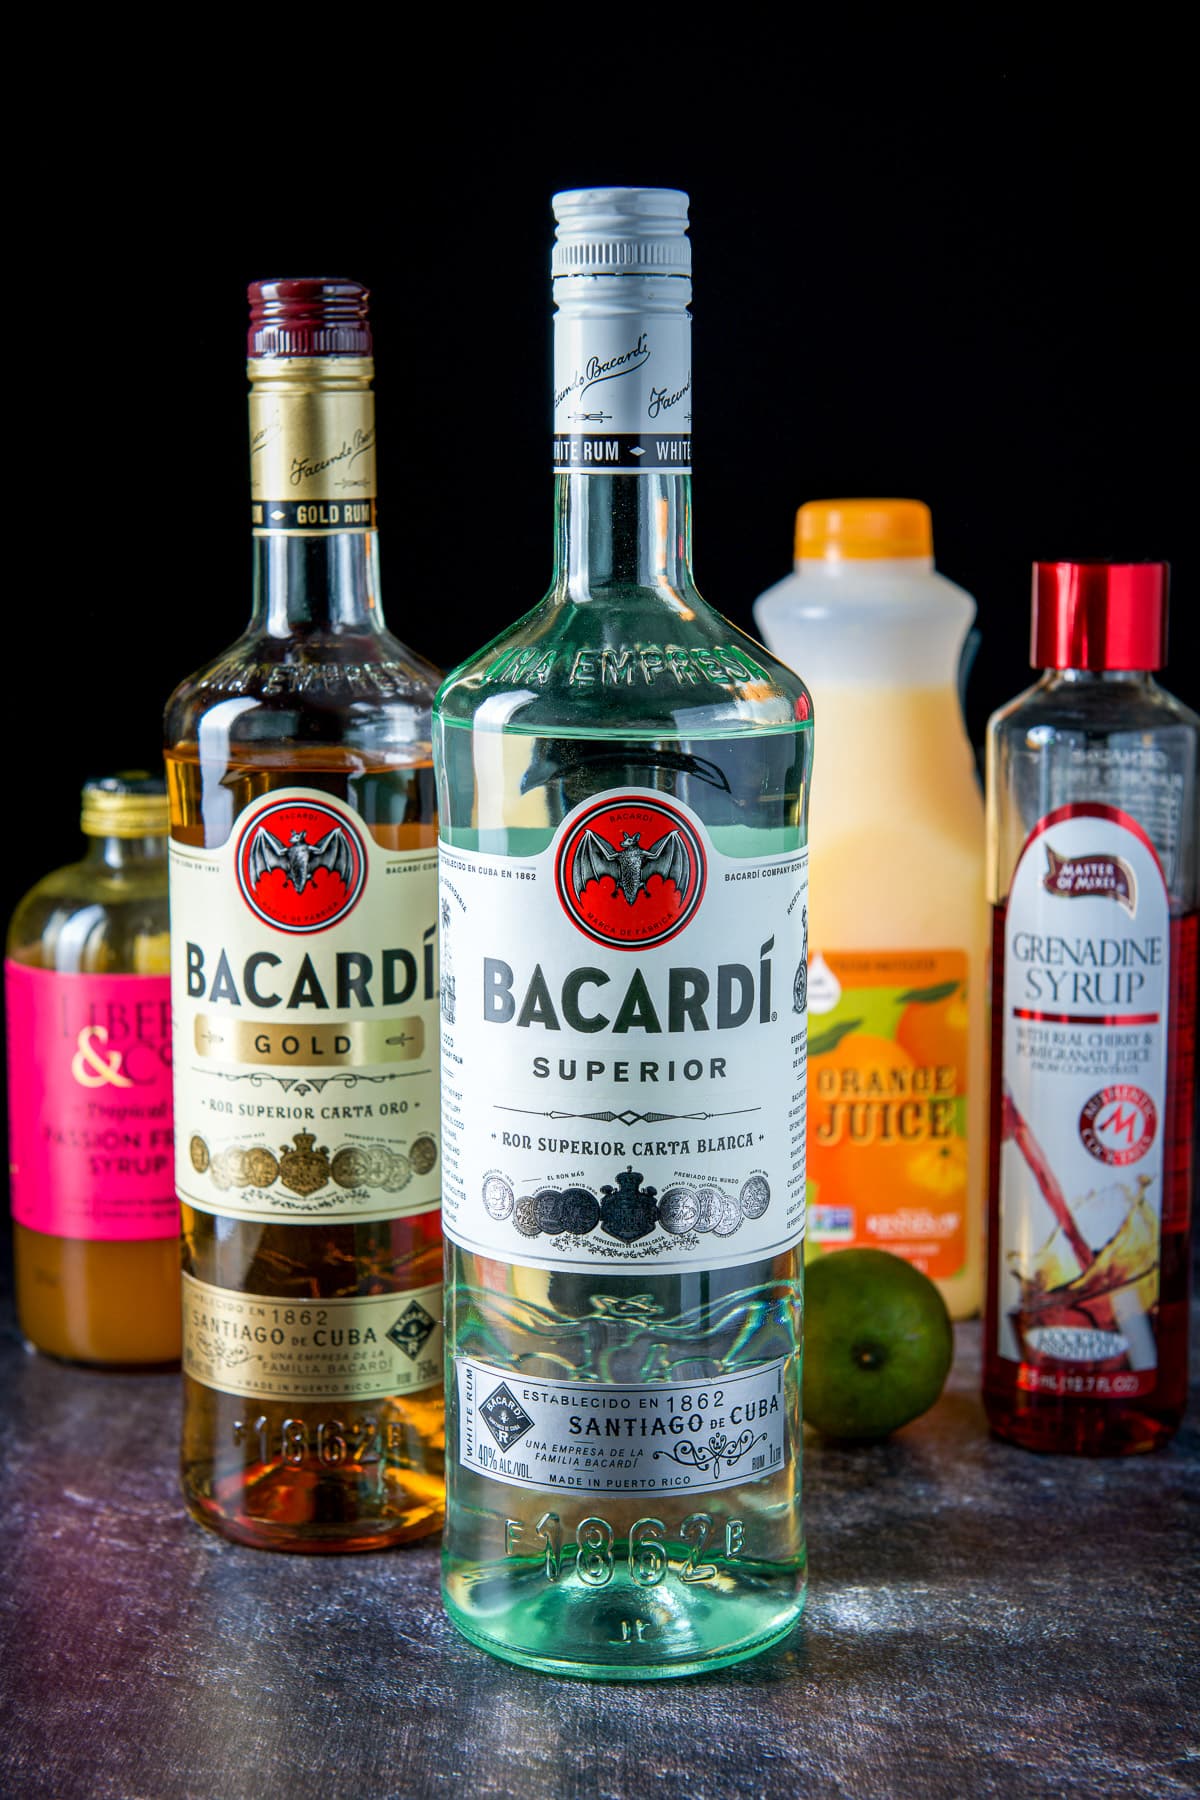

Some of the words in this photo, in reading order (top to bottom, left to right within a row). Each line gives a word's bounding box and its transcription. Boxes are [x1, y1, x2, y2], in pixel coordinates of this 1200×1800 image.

[583, 441, 619, 461] RUM
[656, 441, 691, 461] WHITE
[290, 441, 352, 486] Facundo
[297, 504, 340, 524] GOLD
[344, 504, 370, 524] RUM
[468, 864, 476, 873] EN
[478, 867, 498, 877] CUBA
[501, 870, 512, 878] EN
[515, 872, 537, 881] 1862
[761, 864, 790, 878] COMPANY
[1013, 933, 1162, 967] GRENADINE
[185, 923, 437, 1010] BACARDÍ
[483, 933, 775, 1034] BACARDÍ
[1026, 969, 1145, 1005] SYRUP
[71, 1025, 134, 1088] &
[254, 1034, 352, 1056] GOLD
[532, 1056, 727, 1082] SUPERIOR
[817, 1066, 956, 1098] ORANGE
[209, 1098, 233, 1115] RON
[238, 1103, 315, 1120] SUPERIOR
[321, 1103, 373, 1120] CARTA
[379, 1101, 409, 1117] ORO
[817, 1102, 955, 1146] JUICE
[502, 1131, 532, 1150] RON
[537, 1137, 626, 1156] SUPERIOR
[632, 1140, 690, 1156] CARTA
[697, 1131, 754, 1153] BLANCA
[90, 1156, 170, 1176] SYRUP
[674, 1170, 706, 1181] PREMIADO
[192, 1310, 285, 1345] SANTIAGO
[291, 1336, 308, 1347] DE
[313, 1327, 378, 1348] CUBA
[271, 1309, 328, 1327] 1862
[262, 1361, 320, 1374] FAMILIA
[464, 1368, 473, 1402] RUM
[523, 1390, 631, 1409] ESTABLECIDO
[639, 1398, 658, 1409] EN
[667, 1390, 724, 1413] 1862
[569, 1413, 704, 1437] SANTIAGO
[711, 1417, 725, 1430] DE
[730, 1395, 779, 1425] CUBA
[464, 1408, 473, 1457] WHITE
[498, 1429, 509, 1444] R
[525, 1439, 547, 1451] UNA
[552, 1444, 604, 1457] EMPRESA
[610, 1448, 625, 1457] DE
[630, 1448, 644, 1457] LA
[535, 1453, 580, 1466] FAMILIA
[478, 1443, 498, 1470] 40%
[498, 1457, 533, 1479] ALC./VOL.
[549, 1474, 582, 1486] MADE
[588, 1479, 600, 1487] IN
[606, 1479, 656, 1488] PUERTO
[661, 1475, 691, 1486] RICO
[504, 1518, 521, 1555] F
[536, 1512, 719, 1588] 1862
[725, 1517, 745, 1558] B
